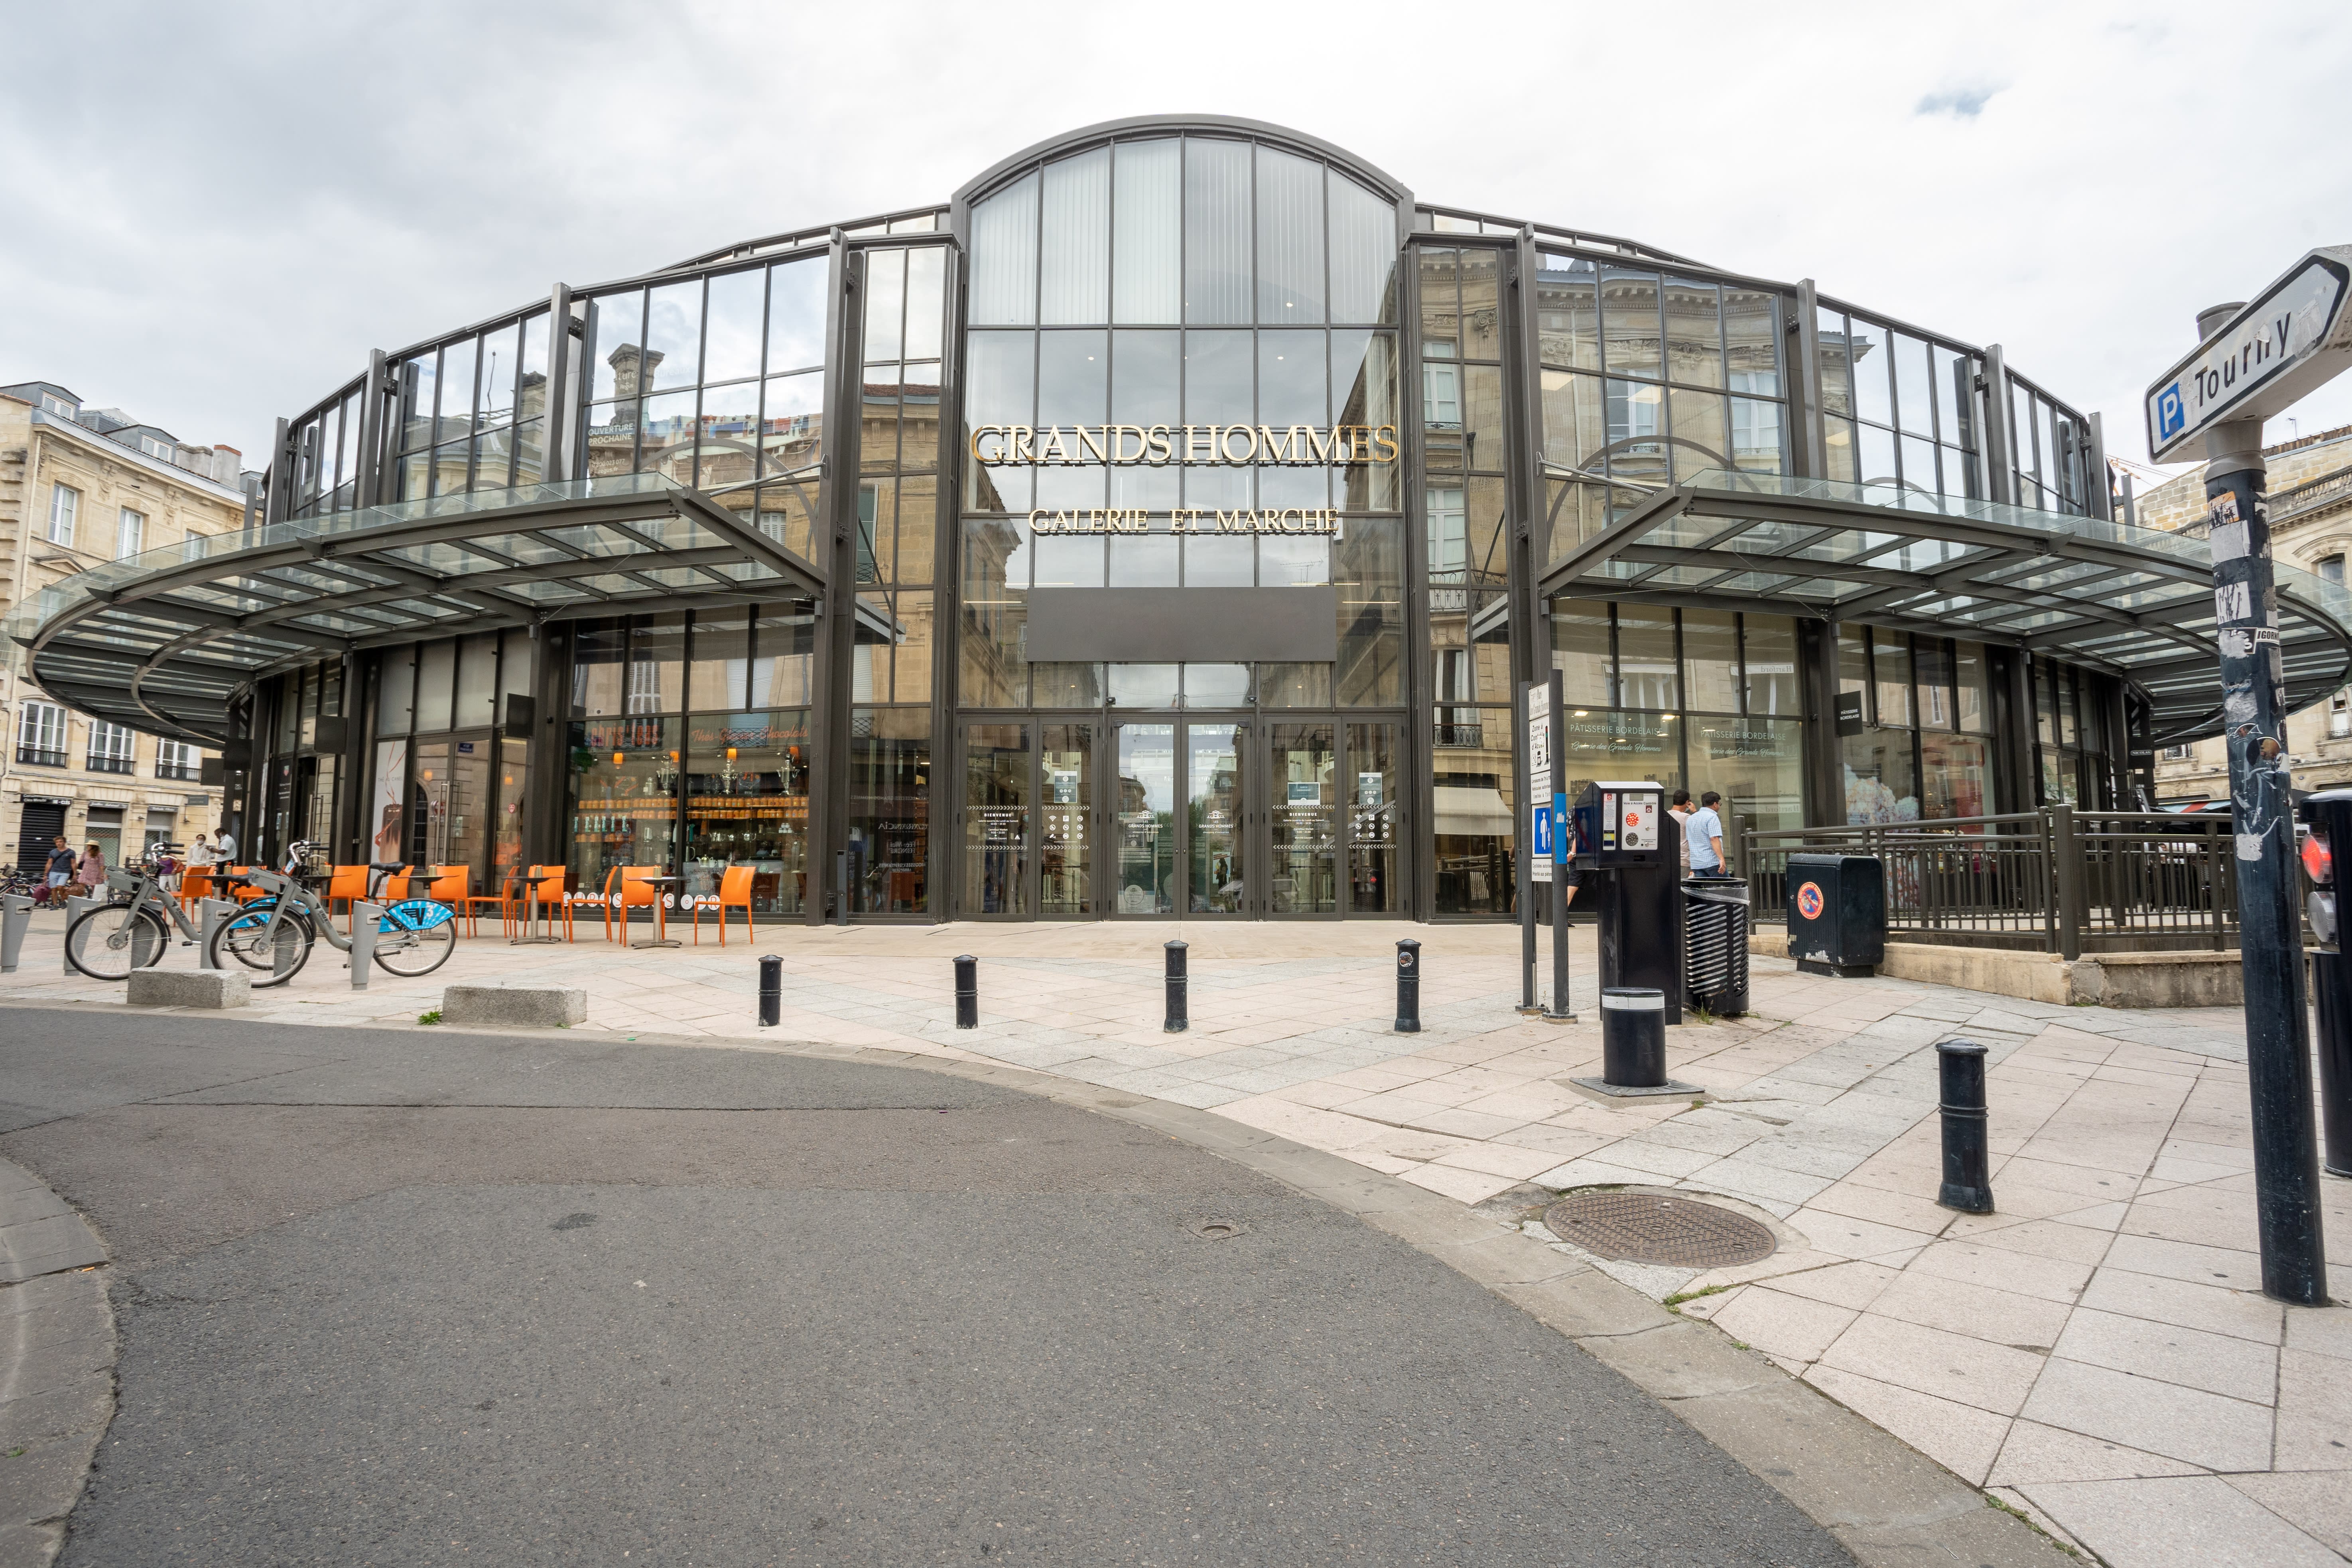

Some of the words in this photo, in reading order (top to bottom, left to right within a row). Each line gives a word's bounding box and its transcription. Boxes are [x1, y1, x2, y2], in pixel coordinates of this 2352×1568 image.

[2194, 312, 2291, 407] Tourny
[971, 424, 1172, 462] GRANDS
[1183, 424, 1399, 462] HOMMES
[1028, 508, 1148, 532] GALERIE
[1169, 509, 1203, 531] ET
[1570, 723, 1613, 733] PÂTISSERIE
[1616, 727, 1663, 735] BORDELAISE
[1743, 732, 1786, 741] BORDELAISE
[1572, 741, 1596, 752] Galerie
[1608, 743, 1633, 753] Grands
[1634, 744, 1662, 753] Hommes
[1702, 747, 1724, 755] Galerie
[1735, 748, 1758, 757] Grands
[1760, 748, 1785, 757] Hommes
